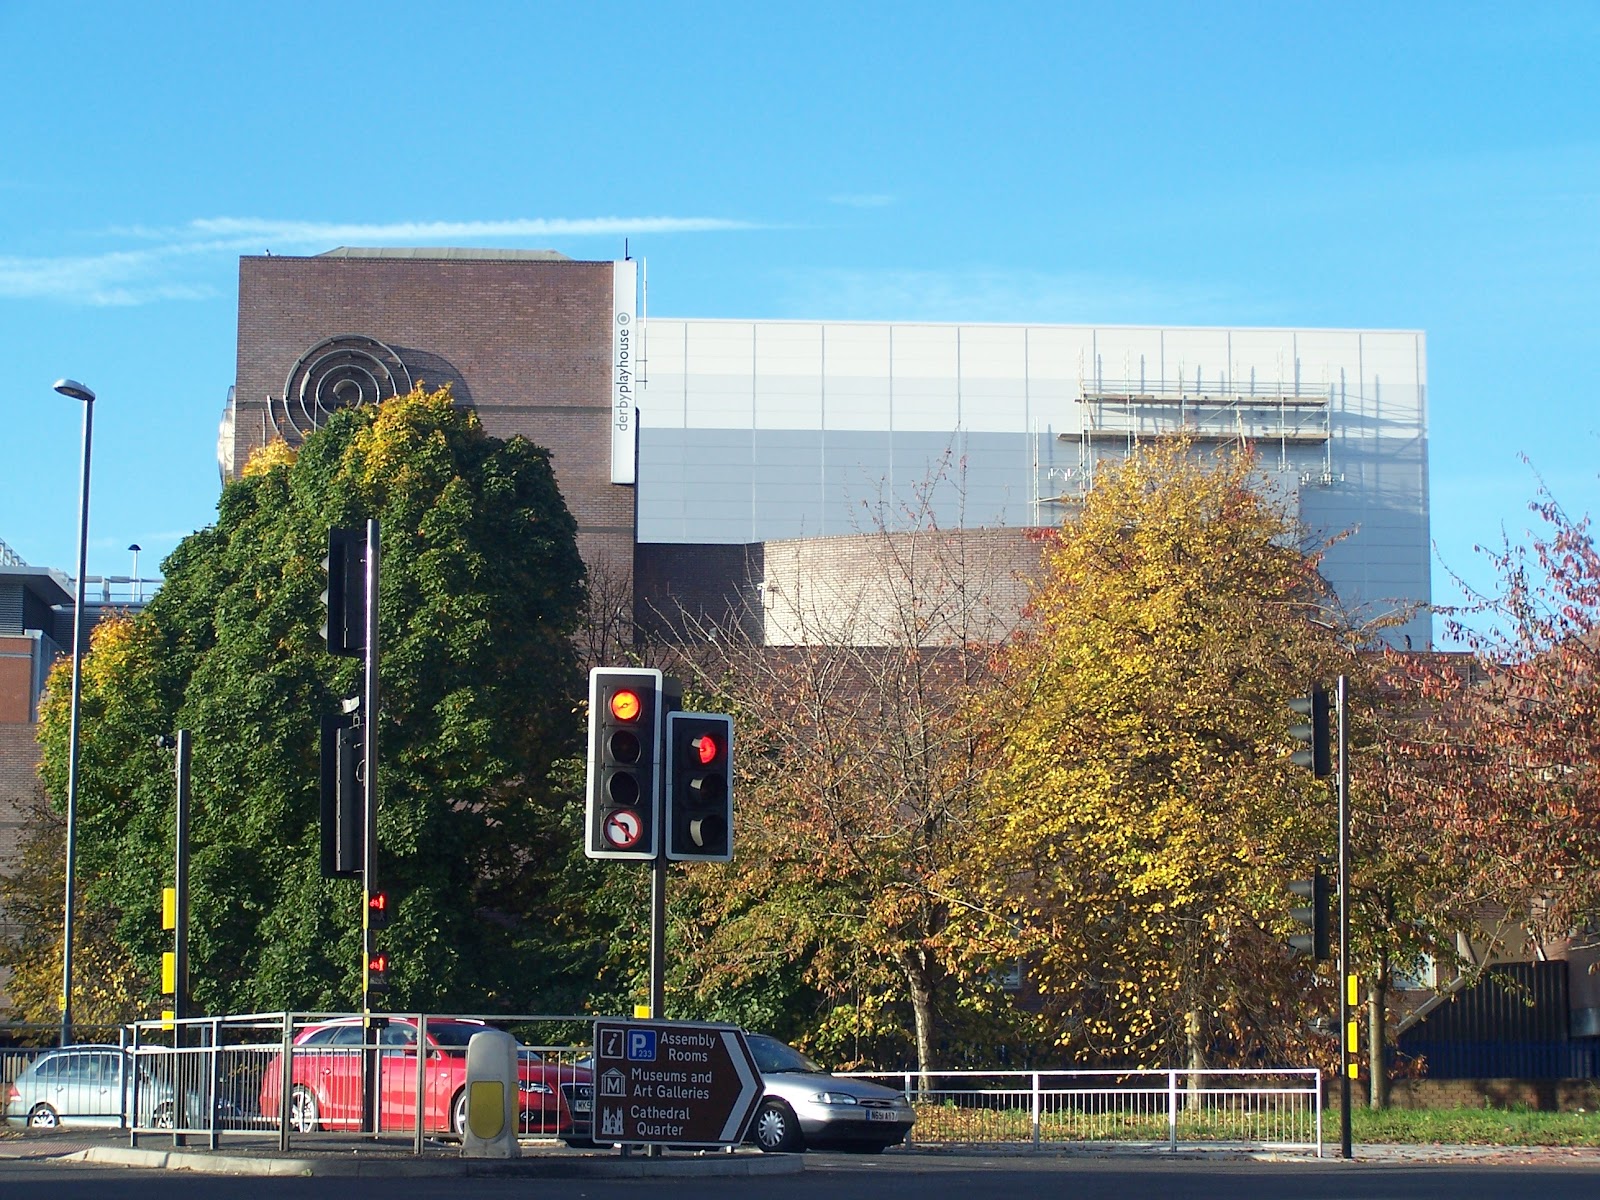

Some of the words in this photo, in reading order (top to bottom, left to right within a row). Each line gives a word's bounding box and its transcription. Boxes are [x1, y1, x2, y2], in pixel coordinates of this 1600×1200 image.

[616, 329, 632, 431] derbyplayhouse
[632, 1033, 647, 1057] P
[660, 1031, 716, 1049] Assembly
[638, 1050, 652, 1058] 233
[668, 1048, 708, 1062] Rooms
[631, 1067, 687, 1083] Museums
[691, 1071, 712, 1083] and
[606, 1077, 620, 1094] M
[633, 1084, 652, 1097] Art
[656, 1084, 709, 1099] Galleries
[630, 1105, 690, 1120] Cathedral
[637, 1121, 684, 1136] Quarter
